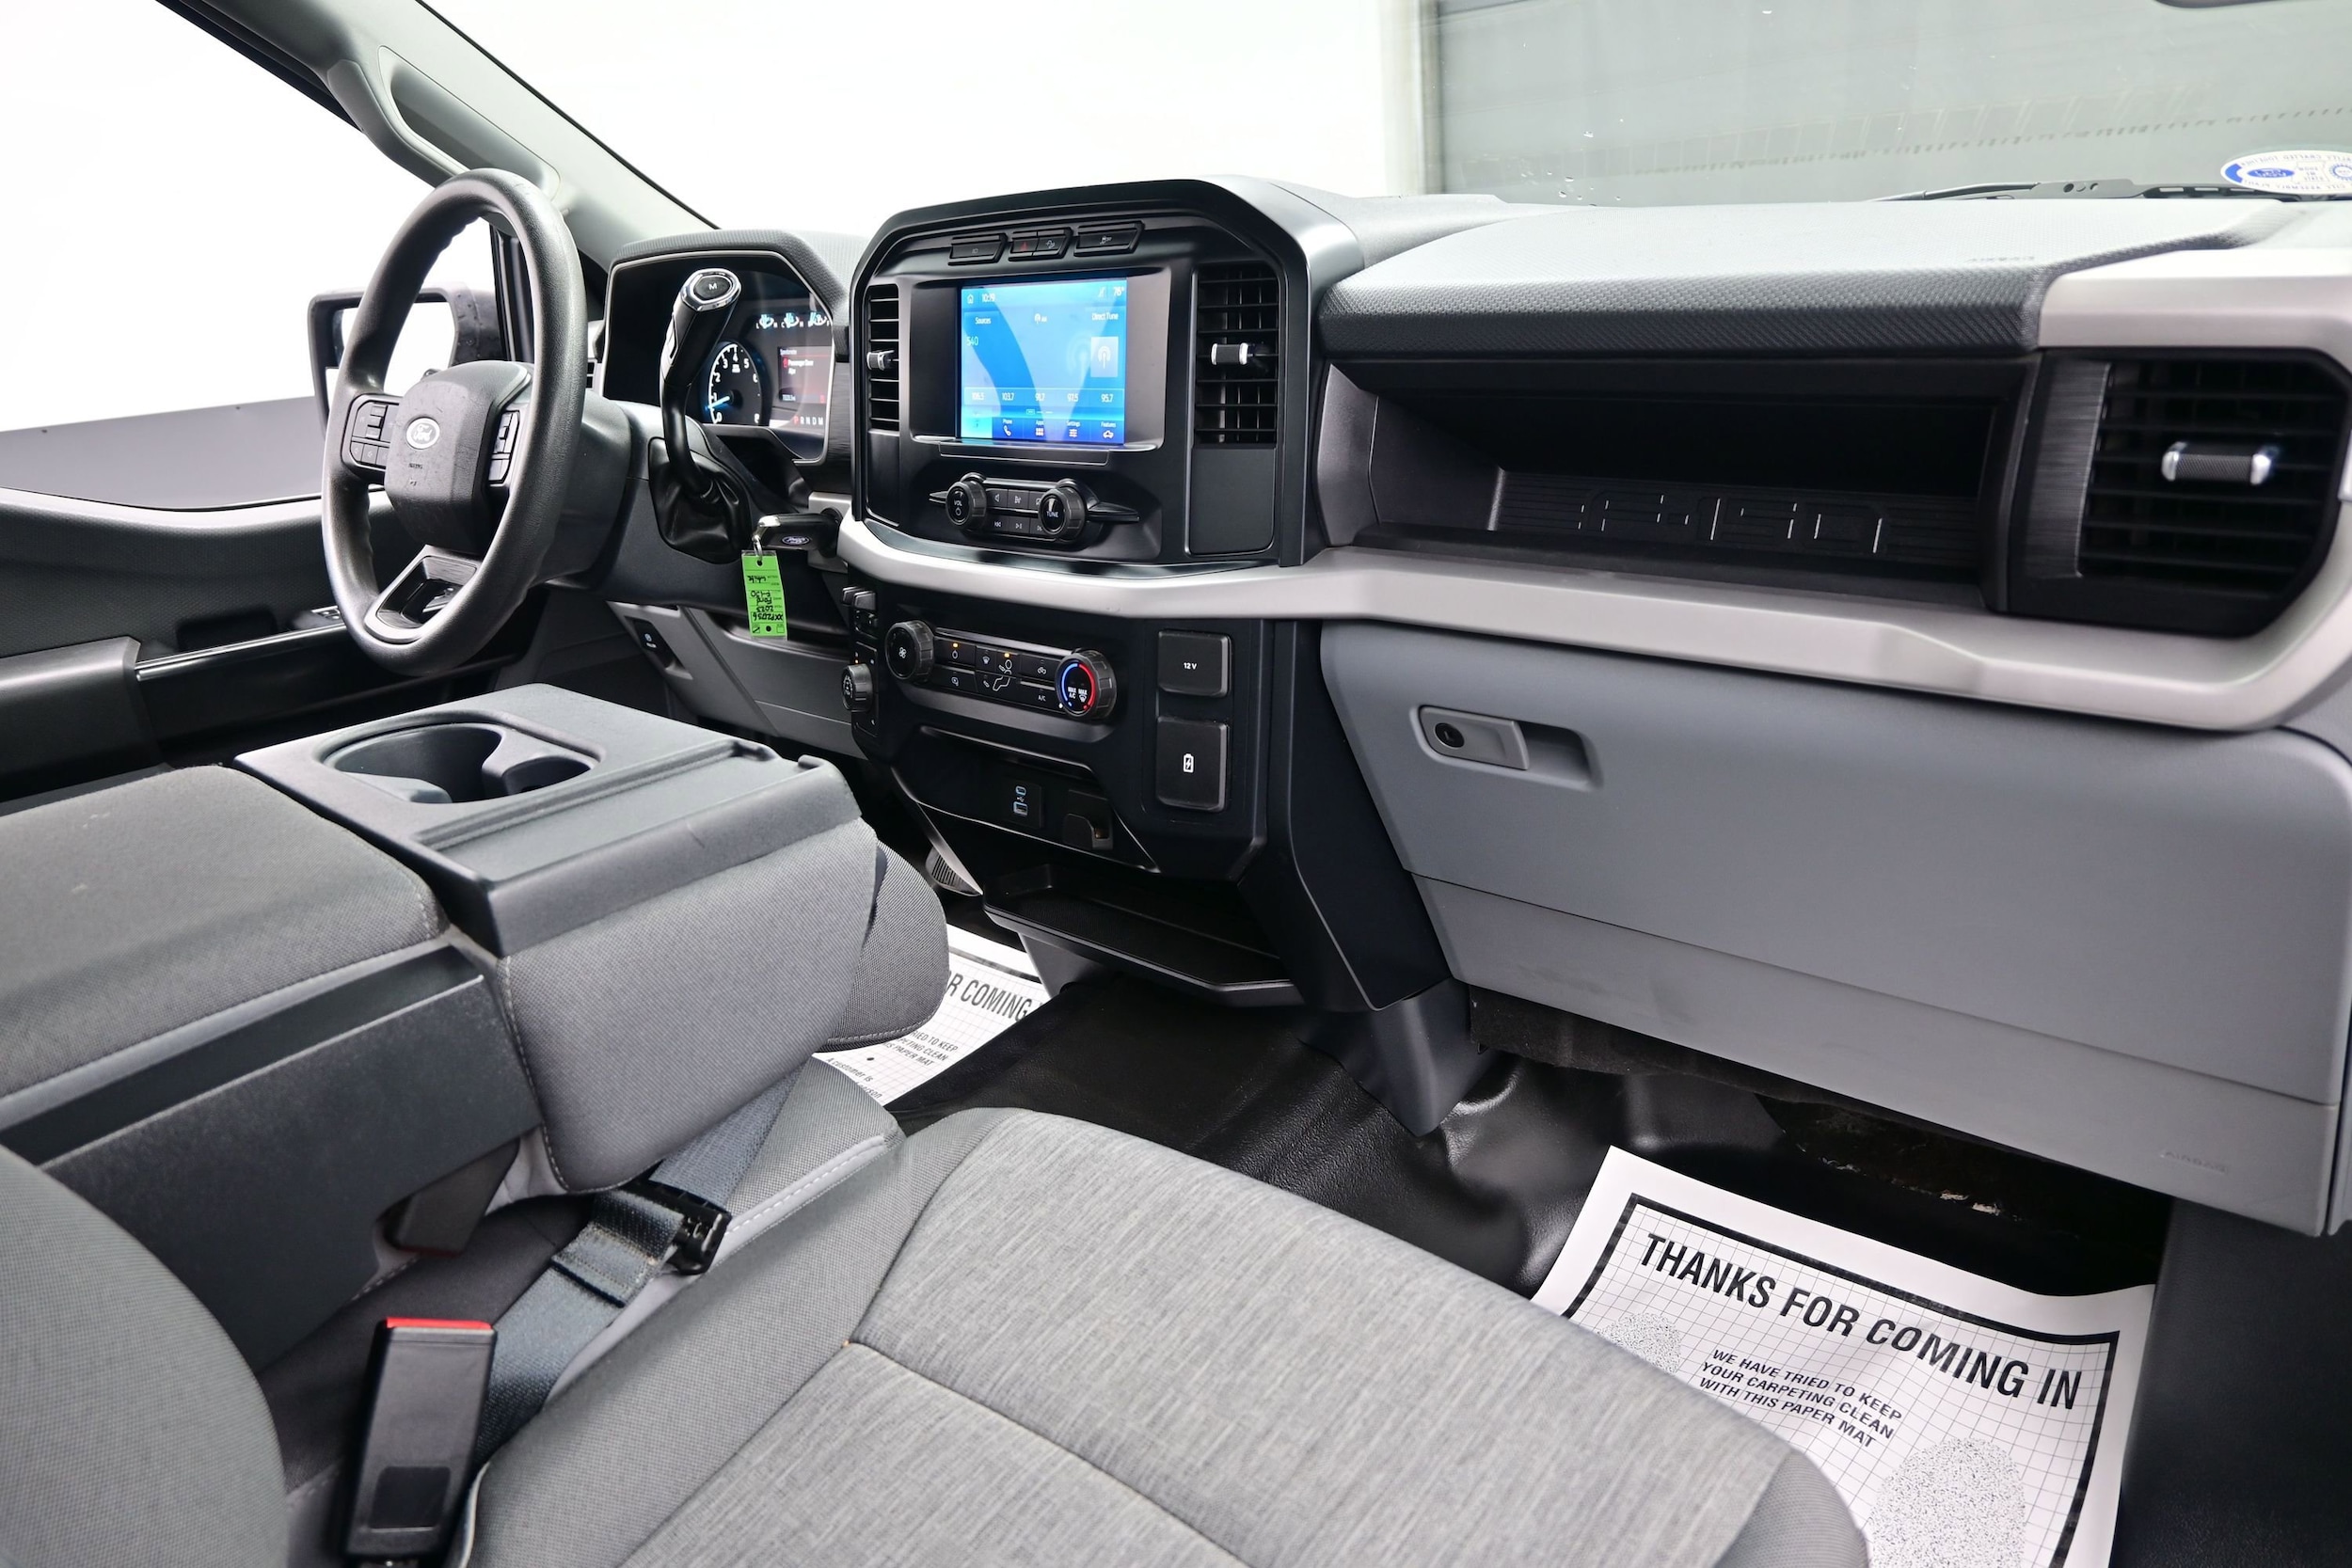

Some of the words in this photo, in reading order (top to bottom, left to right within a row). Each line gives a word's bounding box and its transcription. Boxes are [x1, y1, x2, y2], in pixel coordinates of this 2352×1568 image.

[708, 282, 718, 291] M
[1641, 1233, 1776, 1308] THANKS
[1780, 1287, 1860, 1337] FOR
[1866, 1319, 2029, 1398] COMING
[2037, 1369, 2082, 1410] IN
[1699, 1377, 1740, 1397] WITH
[1743, 1390, 1779, 1408] THIS
[1781, 1401, 1836, 1425] PAPER
[1837, 1420, 1876, 1448] MAT
[1702, 1361, 1744, 1383] YOUR
[1746, 1377, 1836, 1407] CARPETING
[1838, 1402, 1894, 1439] CLEAN
[1712, 1349, 1738, 1365] WE
[1739, 1358, 1781, 1378] HAVE
[1783, 1370, 1830, 1389] TRIED
[1835, 1383, 1855, 1397] TO
[1858, 1392, 1902, 1420] KEEP
